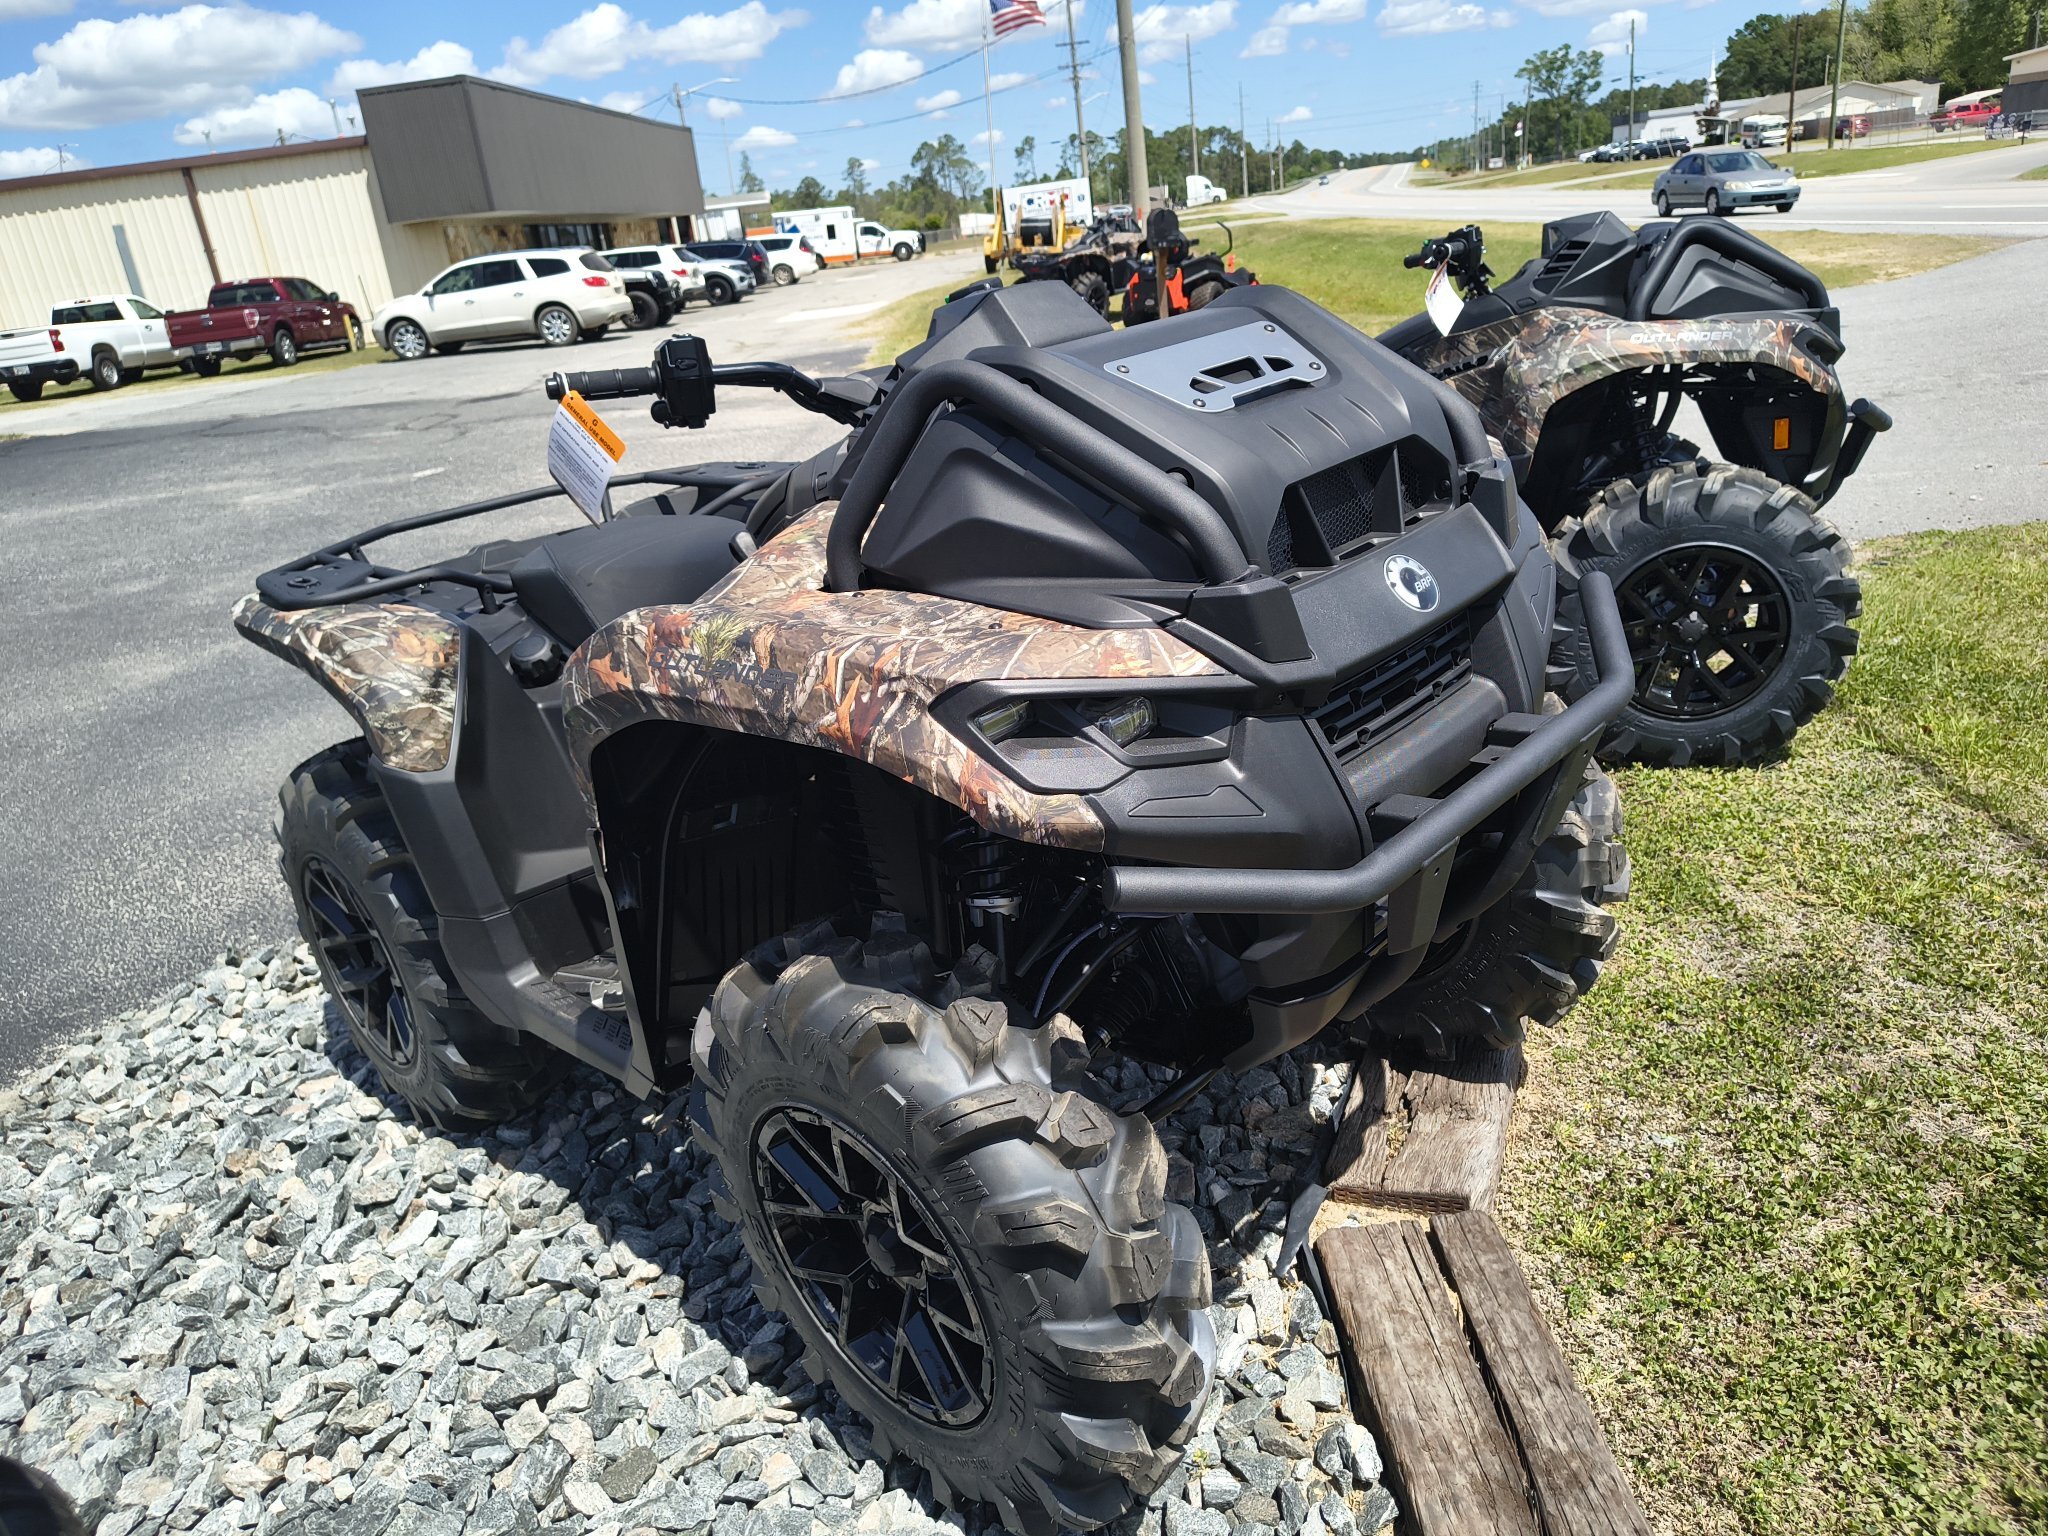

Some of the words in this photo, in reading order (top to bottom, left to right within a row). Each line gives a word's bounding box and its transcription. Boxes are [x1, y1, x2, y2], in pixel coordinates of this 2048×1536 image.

[1629, 331, 1734, 344] OUTLANDER
[566, 402, 589, 428] GENERAL
[589, 426, 600, 438] USE
[599, 437, 617, 457] MODEL
[592, 418, 599, 427] G
[1414, 575, 1432, 593] BRP
[649, 646, 798, 690] OUTLANDER
